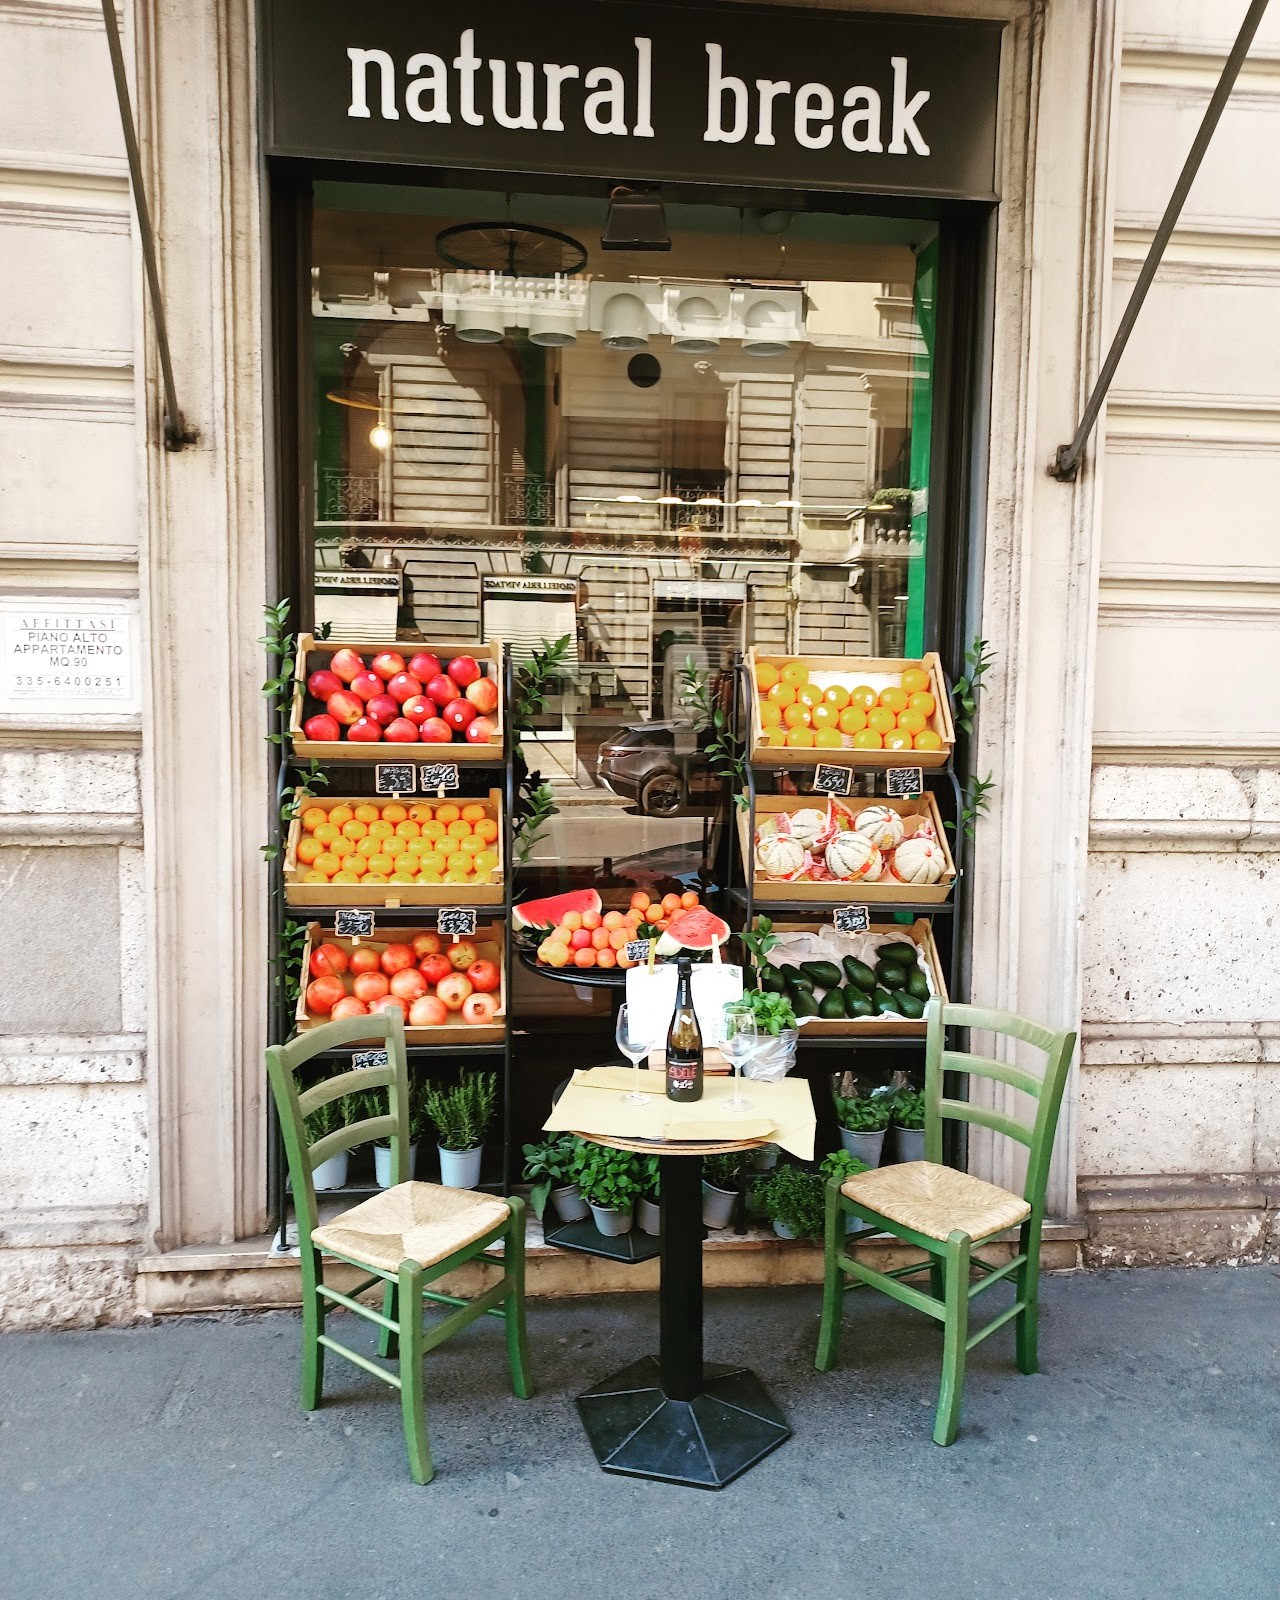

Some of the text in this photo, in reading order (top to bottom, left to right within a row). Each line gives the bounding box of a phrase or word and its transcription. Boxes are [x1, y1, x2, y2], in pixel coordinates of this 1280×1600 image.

[347, 29, 931, 157] natural break
[21, 618, 115, 629] AFFITTASI
[28, 632, 107, 643] PIANO ALTO
[13, 644, 123, 655] APPARTAMENTO
[16, 676, 121, 687] 335-6400251
